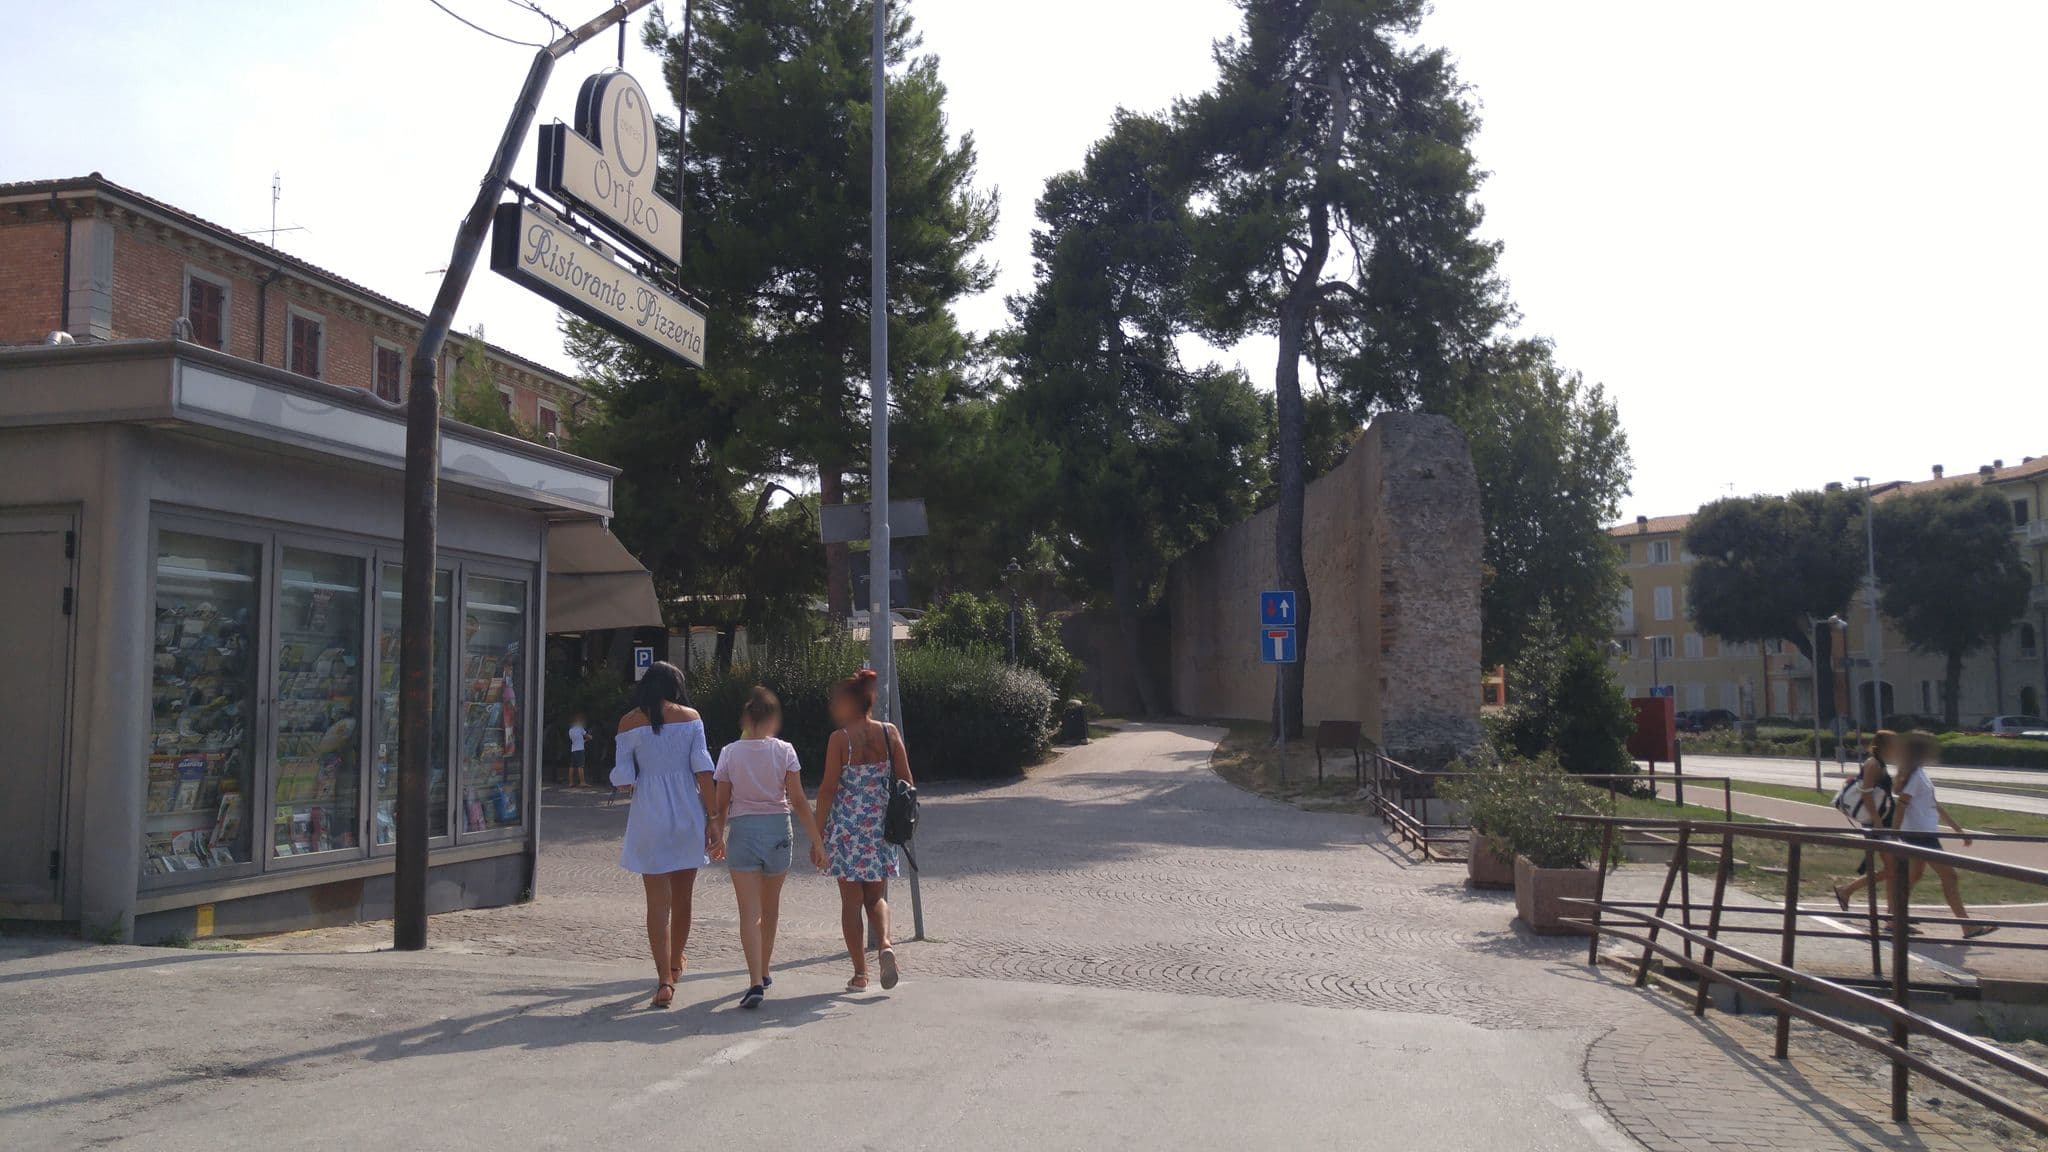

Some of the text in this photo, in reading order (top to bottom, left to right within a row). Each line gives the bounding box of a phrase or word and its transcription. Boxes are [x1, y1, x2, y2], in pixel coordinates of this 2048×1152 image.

[594, 159, 659, 234] Orfeo
[524, 224, 627, 311] Ristorante
[636, 286, 702, 355] Pizzeria
[639, 651, 649, 666] P
